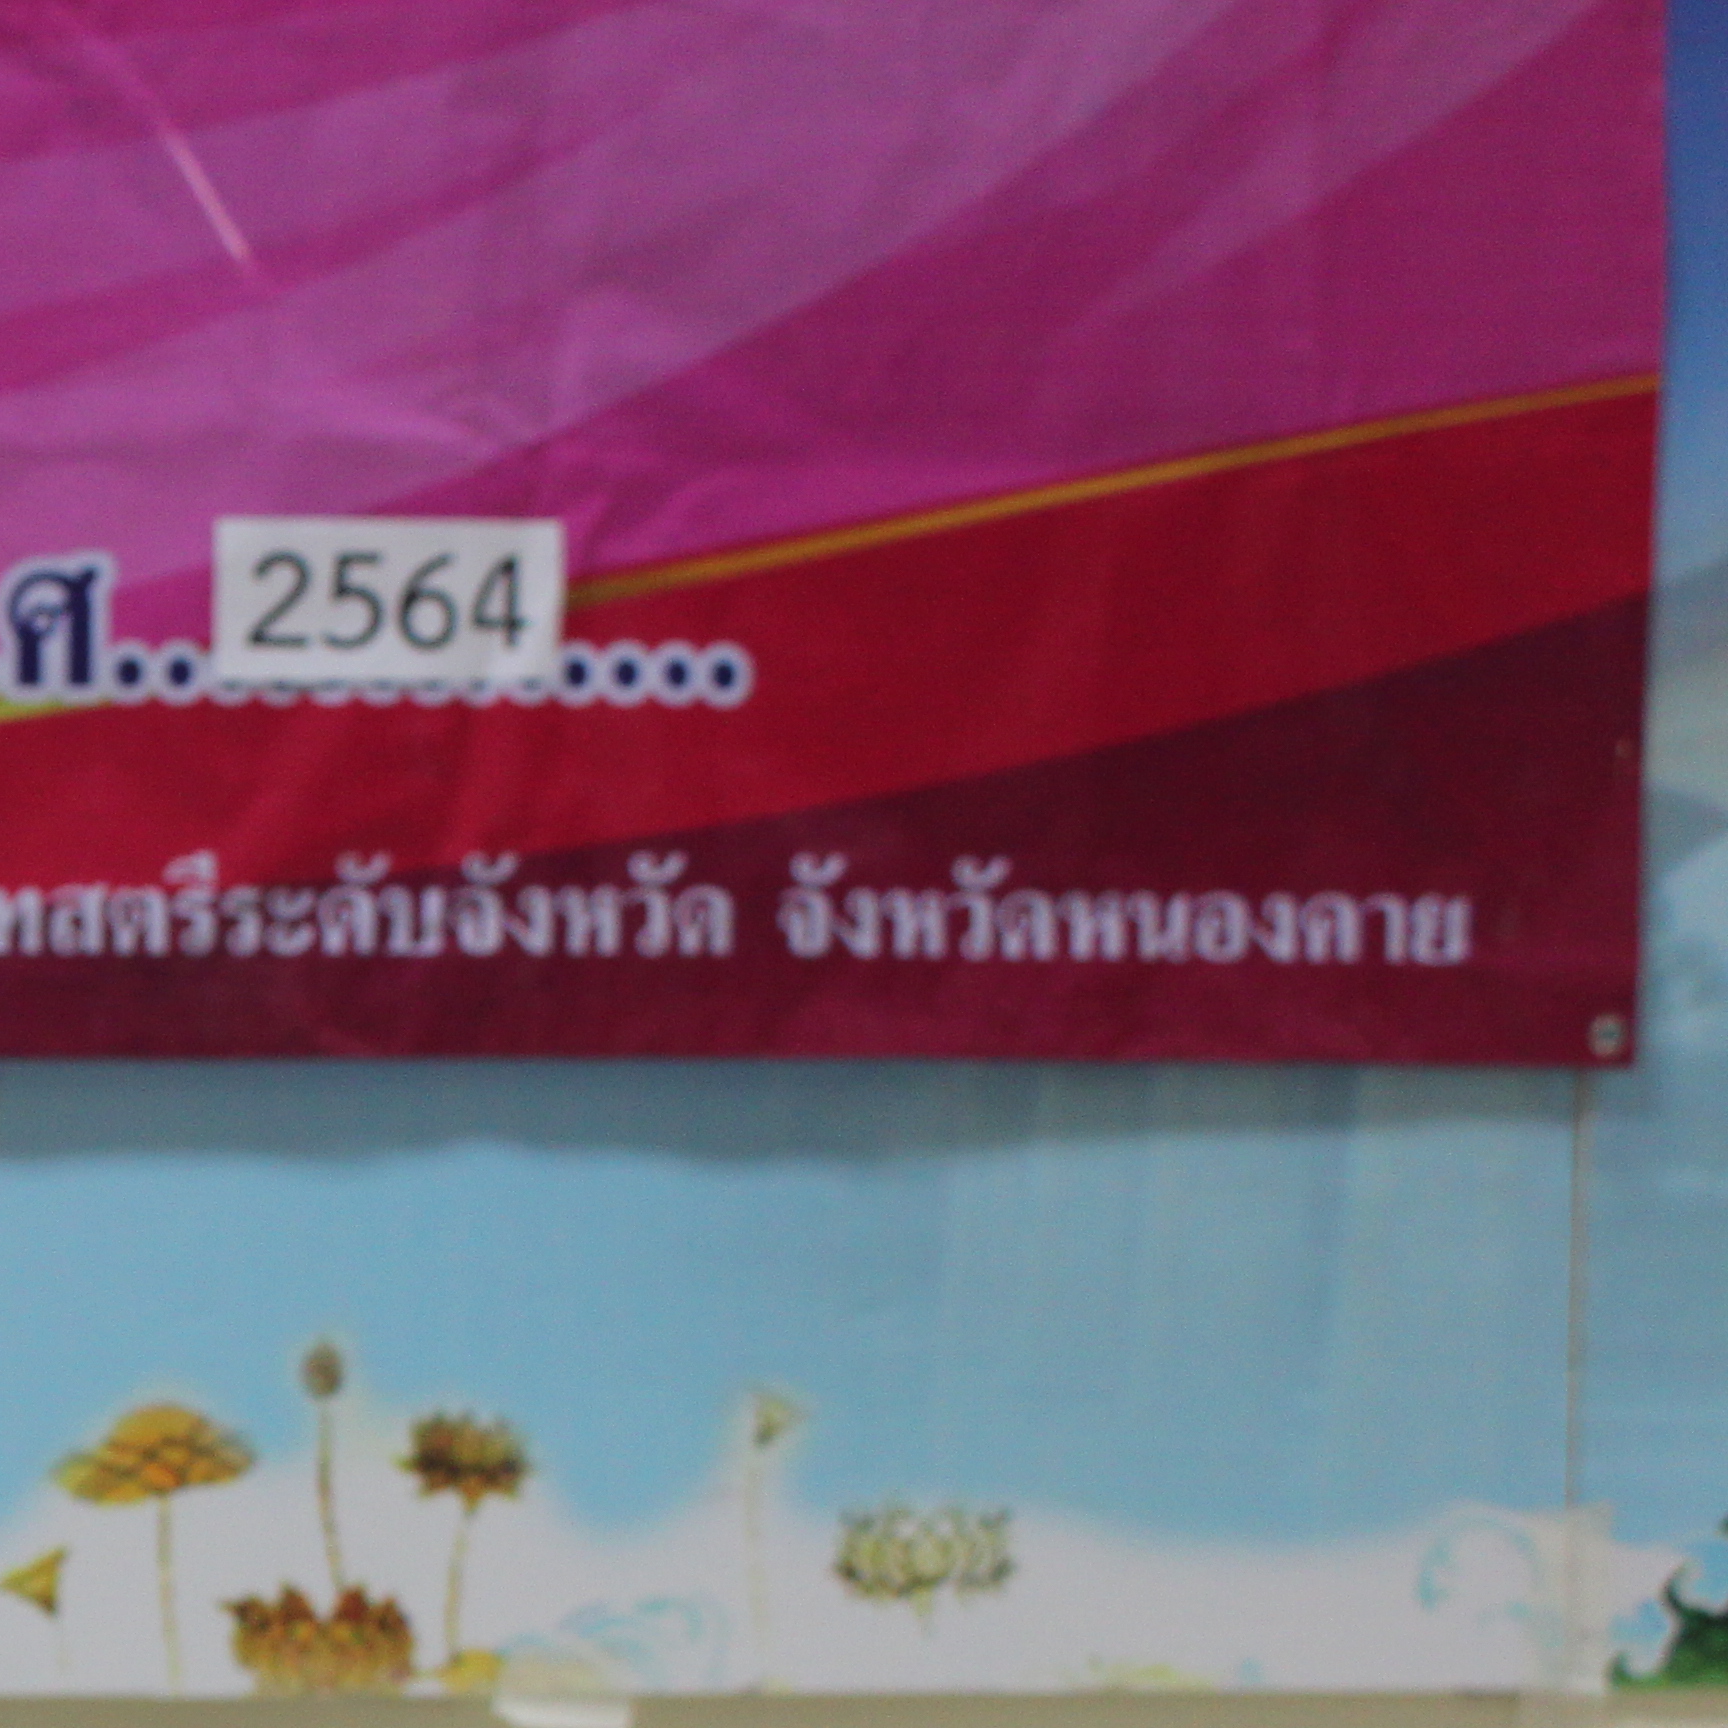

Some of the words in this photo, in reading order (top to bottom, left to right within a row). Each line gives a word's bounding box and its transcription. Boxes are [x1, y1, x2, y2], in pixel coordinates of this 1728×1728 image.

[242, 546, 536, 652] 2564
[775, 850, 1473, 968] จังหวัดหนองคาย
